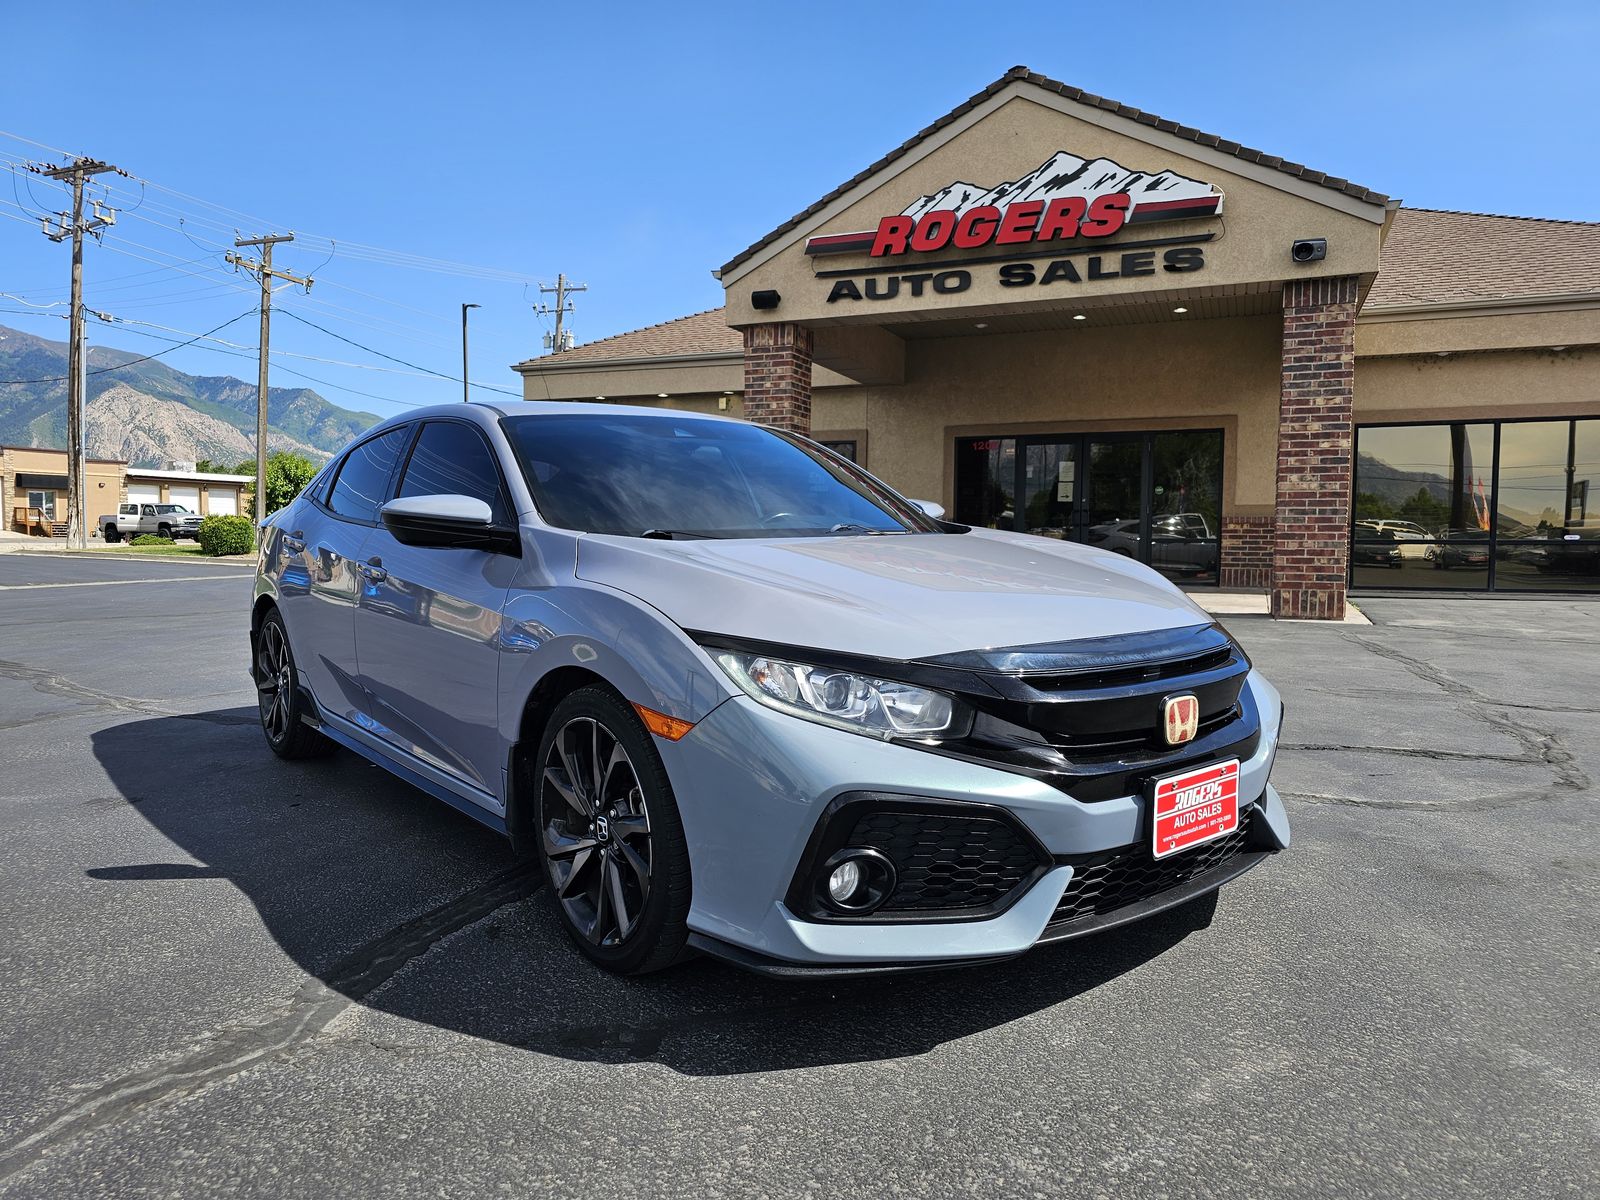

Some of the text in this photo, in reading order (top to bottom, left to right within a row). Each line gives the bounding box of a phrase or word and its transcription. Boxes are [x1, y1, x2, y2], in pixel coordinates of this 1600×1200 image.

[870, 194, 1131, 257] ROGERS
[826, 247, 1205, 303] AUTO SALES
[1174, 781, 1223, 812] ROGERS
[1174, 803, 1222, 829] AUTO SALES
